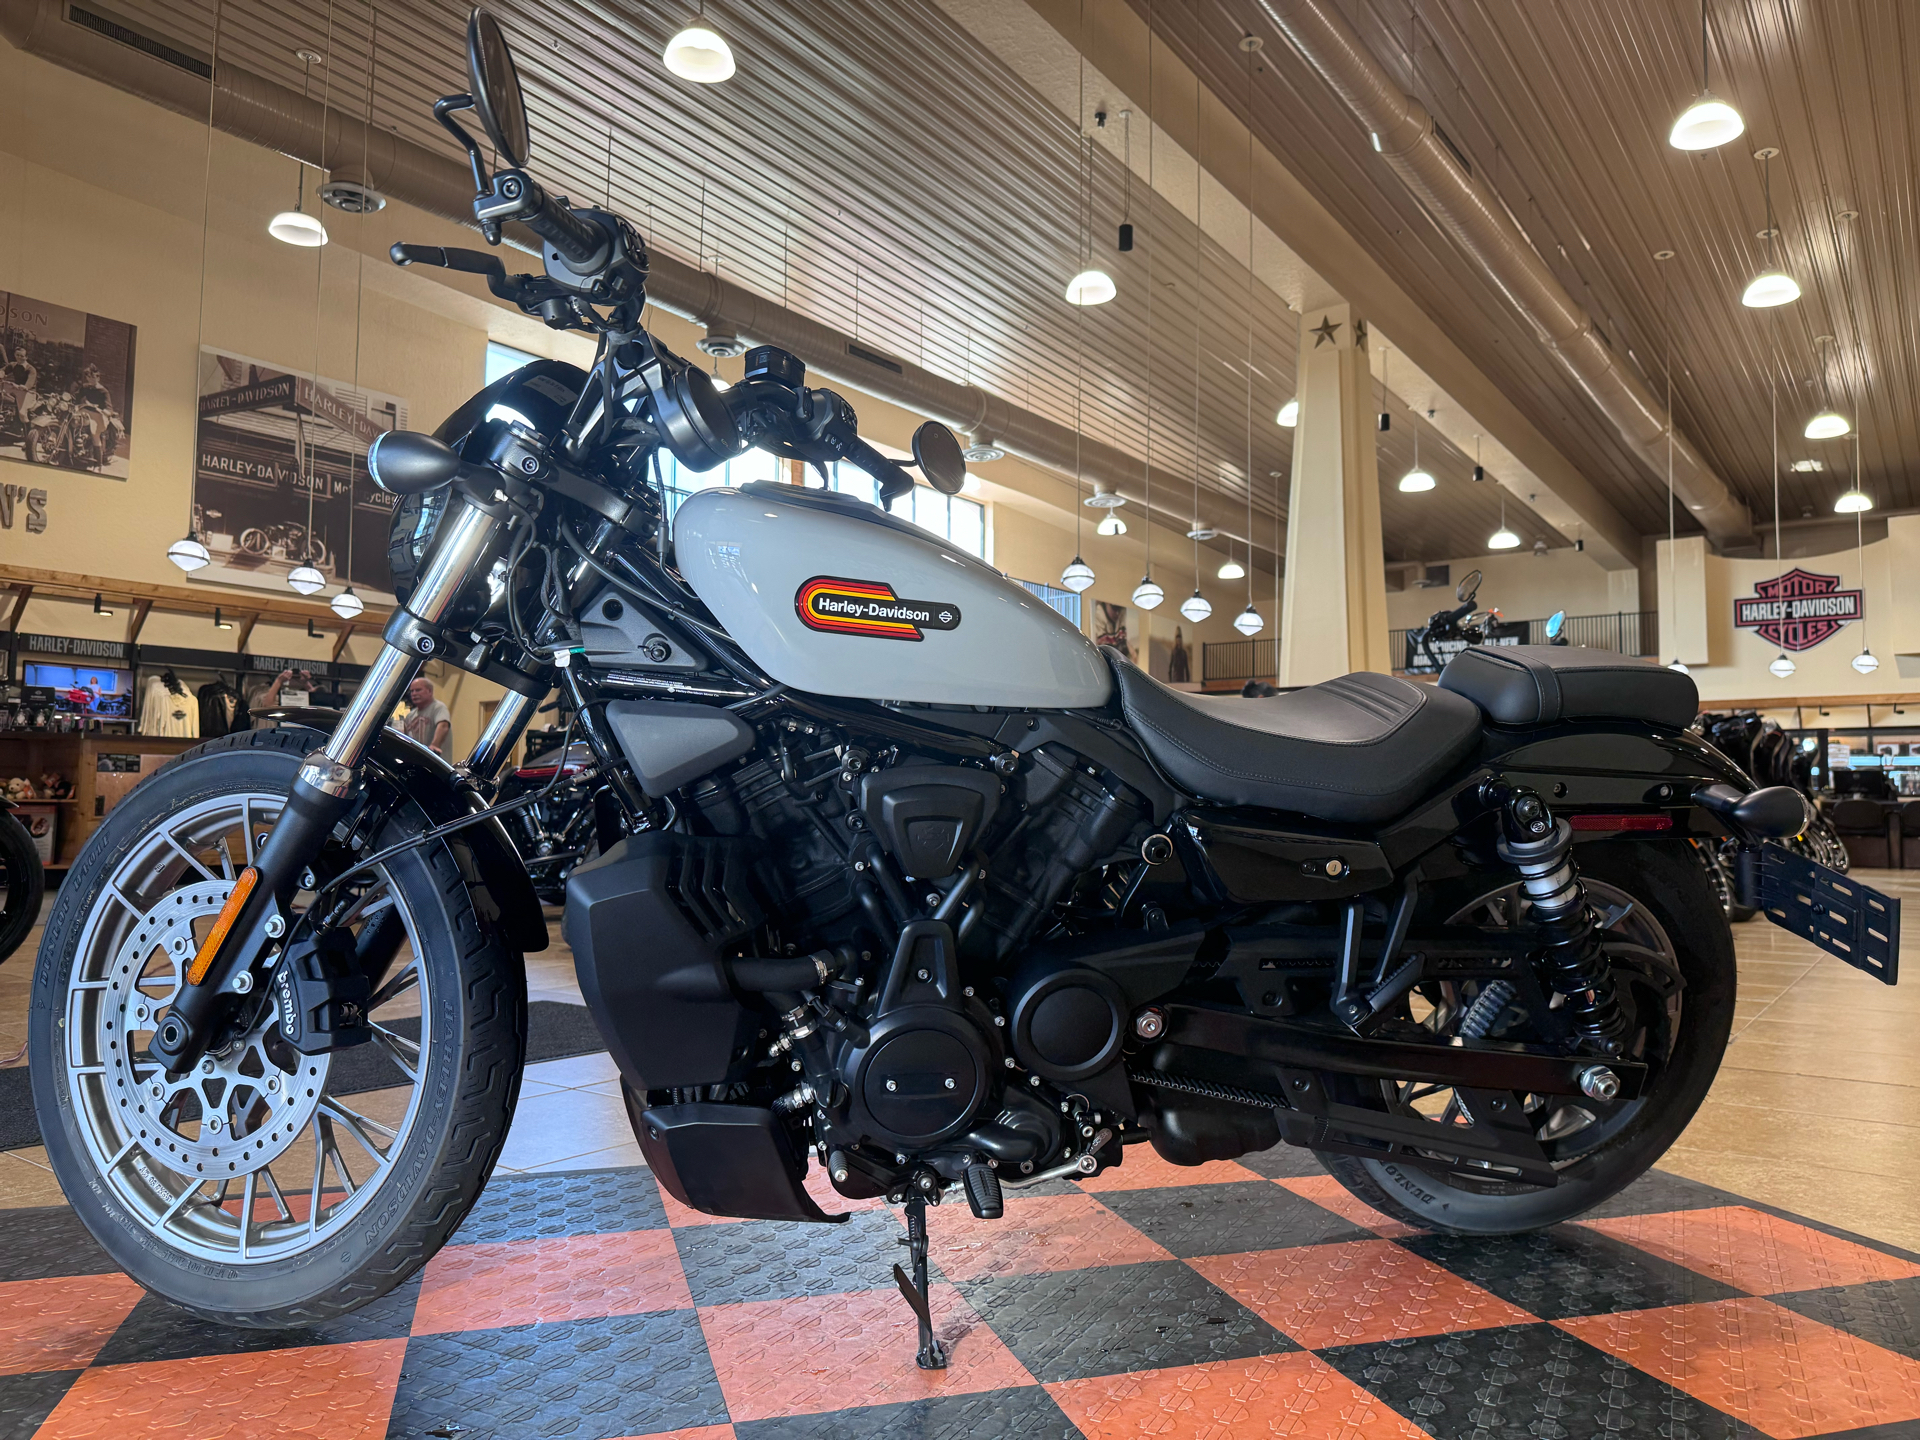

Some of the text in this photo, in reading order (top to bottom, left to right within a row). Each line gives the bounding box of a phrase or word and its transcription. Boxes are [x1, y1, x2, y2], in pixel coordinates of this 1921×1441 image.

[200, 382, 290, 411] HARLEY-DAVIDSON
[202, 453, 324, 490] HARLEY-DAVIDSON
[1767, 577, 1827, 597] MOTOR
[818, 597, 930, 622] Harley-Davidson
[1741, 596, 1855, 622] HARLEY-DAVIDSON
[1768, 620, 1828, 645] CYCLES
[29, 635, 124, 658] HARLEY-DAVIDSON
[253, 656, 328, 675] HARLEY-DAVIDSON
[40, 896, 71, 988] DUNLOP
[277, 970, 297, 1035] brembo
[365, 1004, 455, 1246] HARLEY-DAVIDSON
